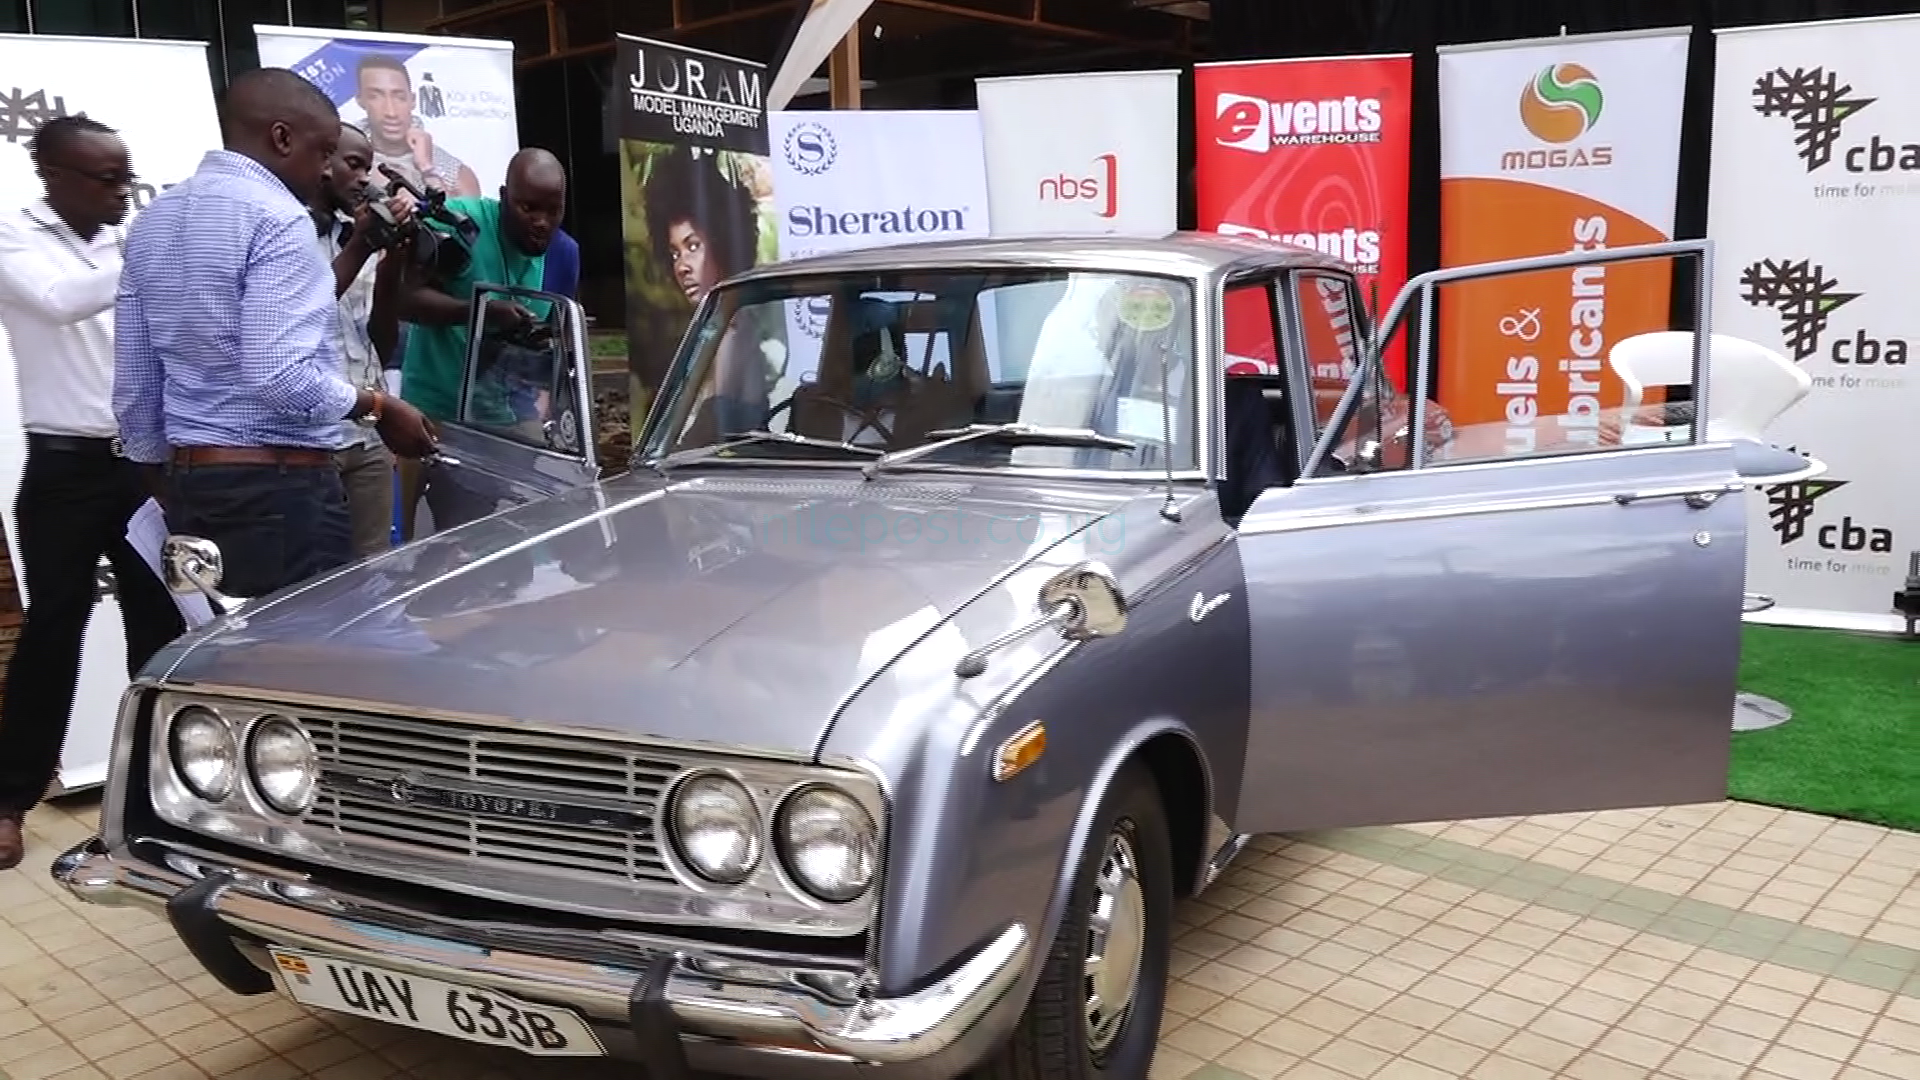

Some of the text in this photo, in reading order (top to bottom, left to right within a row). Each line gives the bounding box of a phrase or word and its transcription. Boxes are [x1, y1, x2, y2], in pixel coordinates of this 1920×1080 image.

[630, 49, 761, 109] JORAM
[633, 94, 760, 129] MODEL MANAGEMENT
[672, 116, 725, 138] UGANDA
[1271, 133, 1382, 146] WAREHOUSE
[1845, 134, 1920, 174] cba
[1500, 146, 1613, 171] MOGAS
[1813, 183, 1850, 198] time
[1853, 180, 1876, 197] for
[1499, 307, 1541, 341] &
[1831, 328, 1908, 365] cba
[1839, 373, 1861, 388] for
[1818, 516, 1893, 553] cba
[1787, 557, 1823, 571] time
[1826, 558, 1847, 573] for
[326, 963, 568, 1050] UAY 633B
